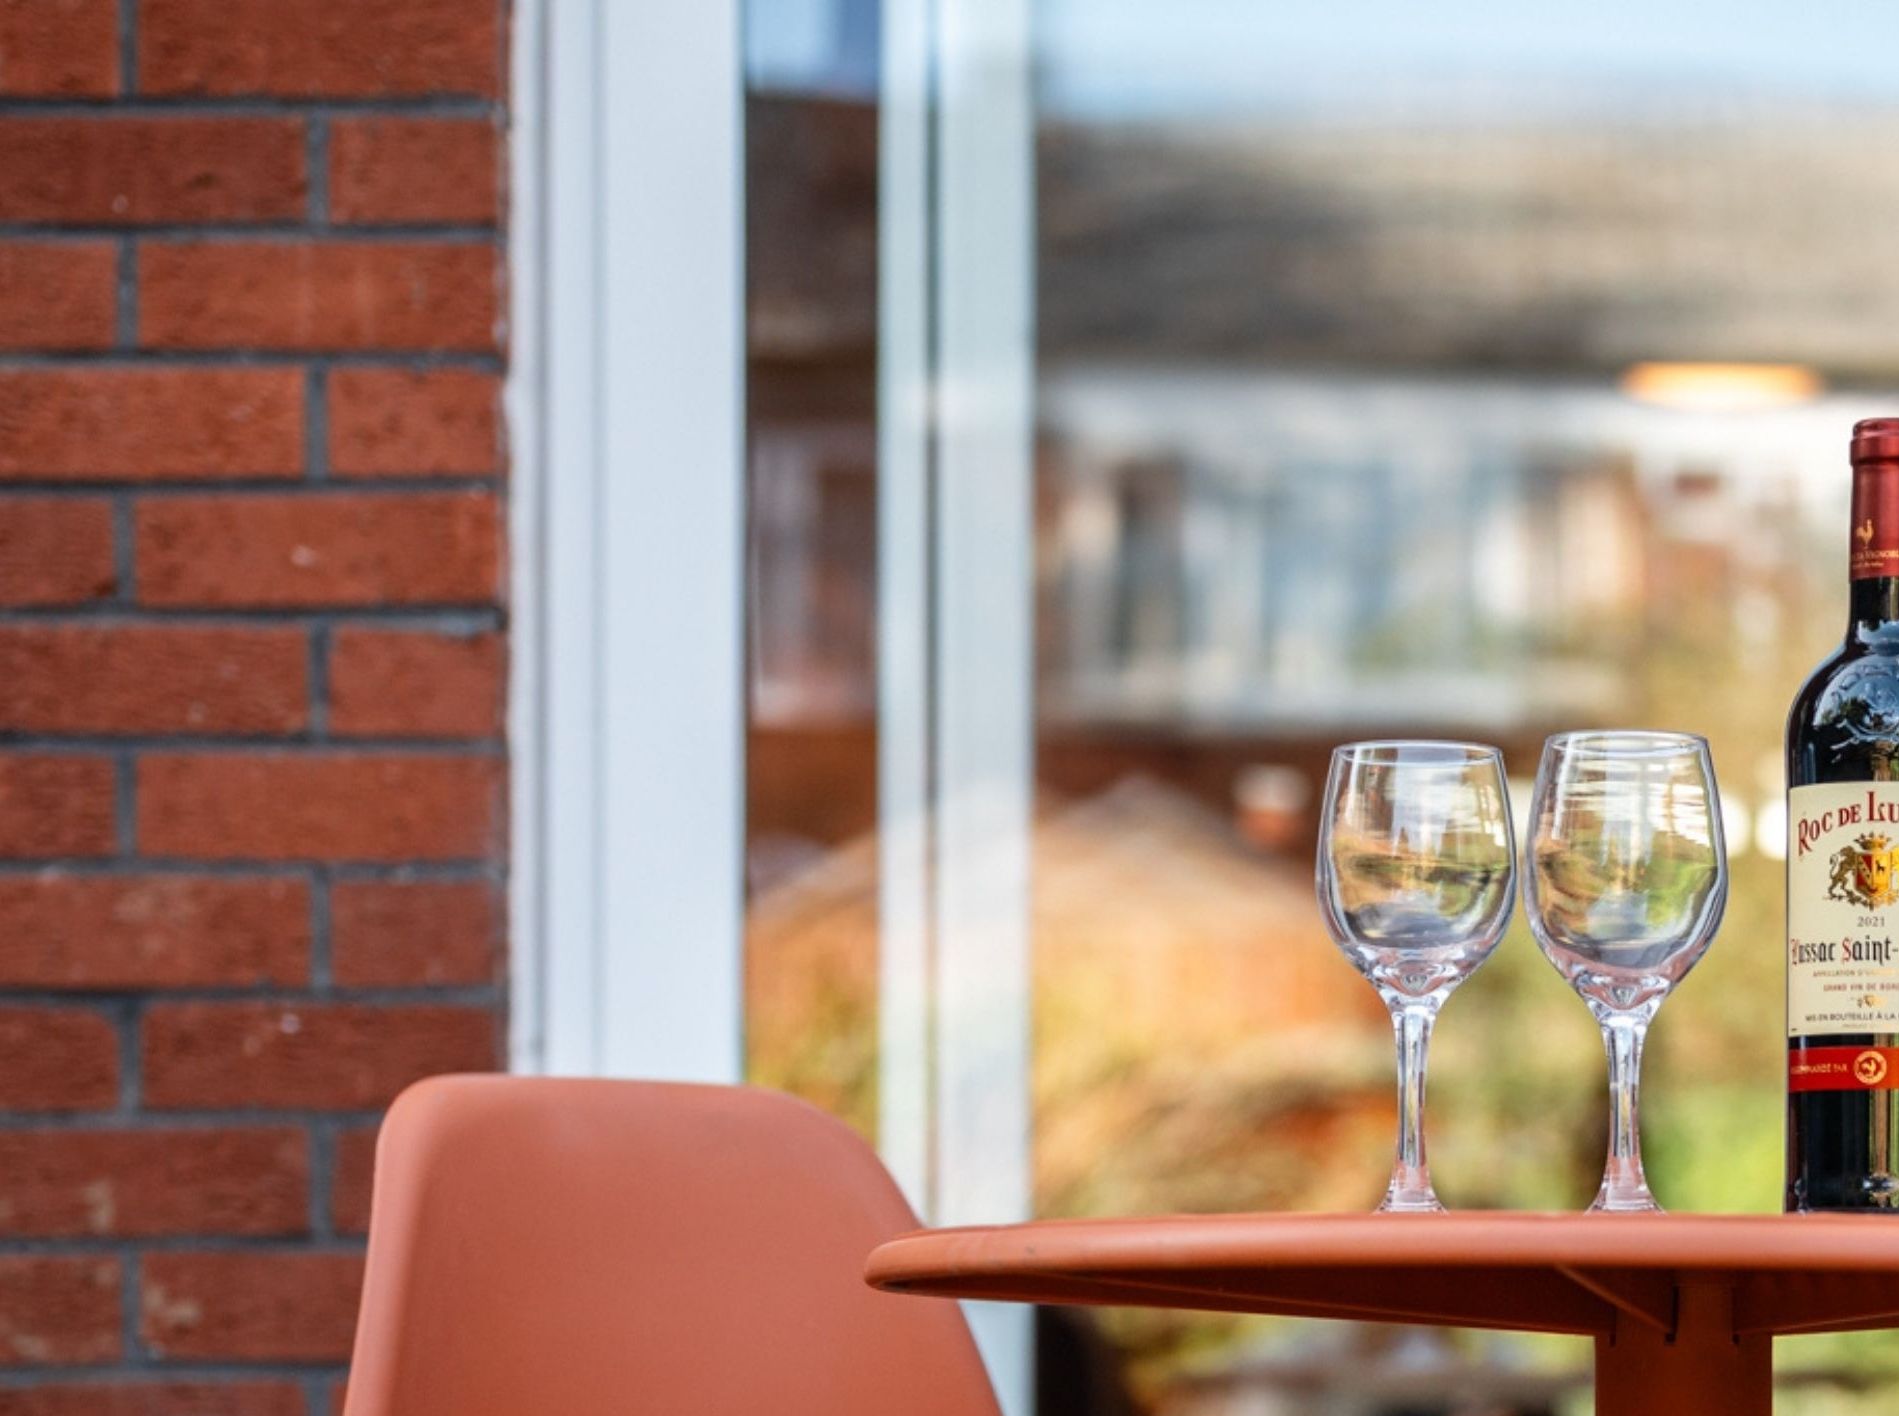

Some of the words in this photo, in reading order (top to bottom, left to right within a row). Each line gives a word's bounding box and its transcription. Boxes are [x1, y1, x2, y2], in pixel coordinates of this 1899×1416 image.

[1838, 804, 1861, 827] DE
[1857, 916, 1885, 927] 2021
[1830, 1012, 1875, 1021] BOUTEILLE
[1884, 1012, 1896, 1020] LA
